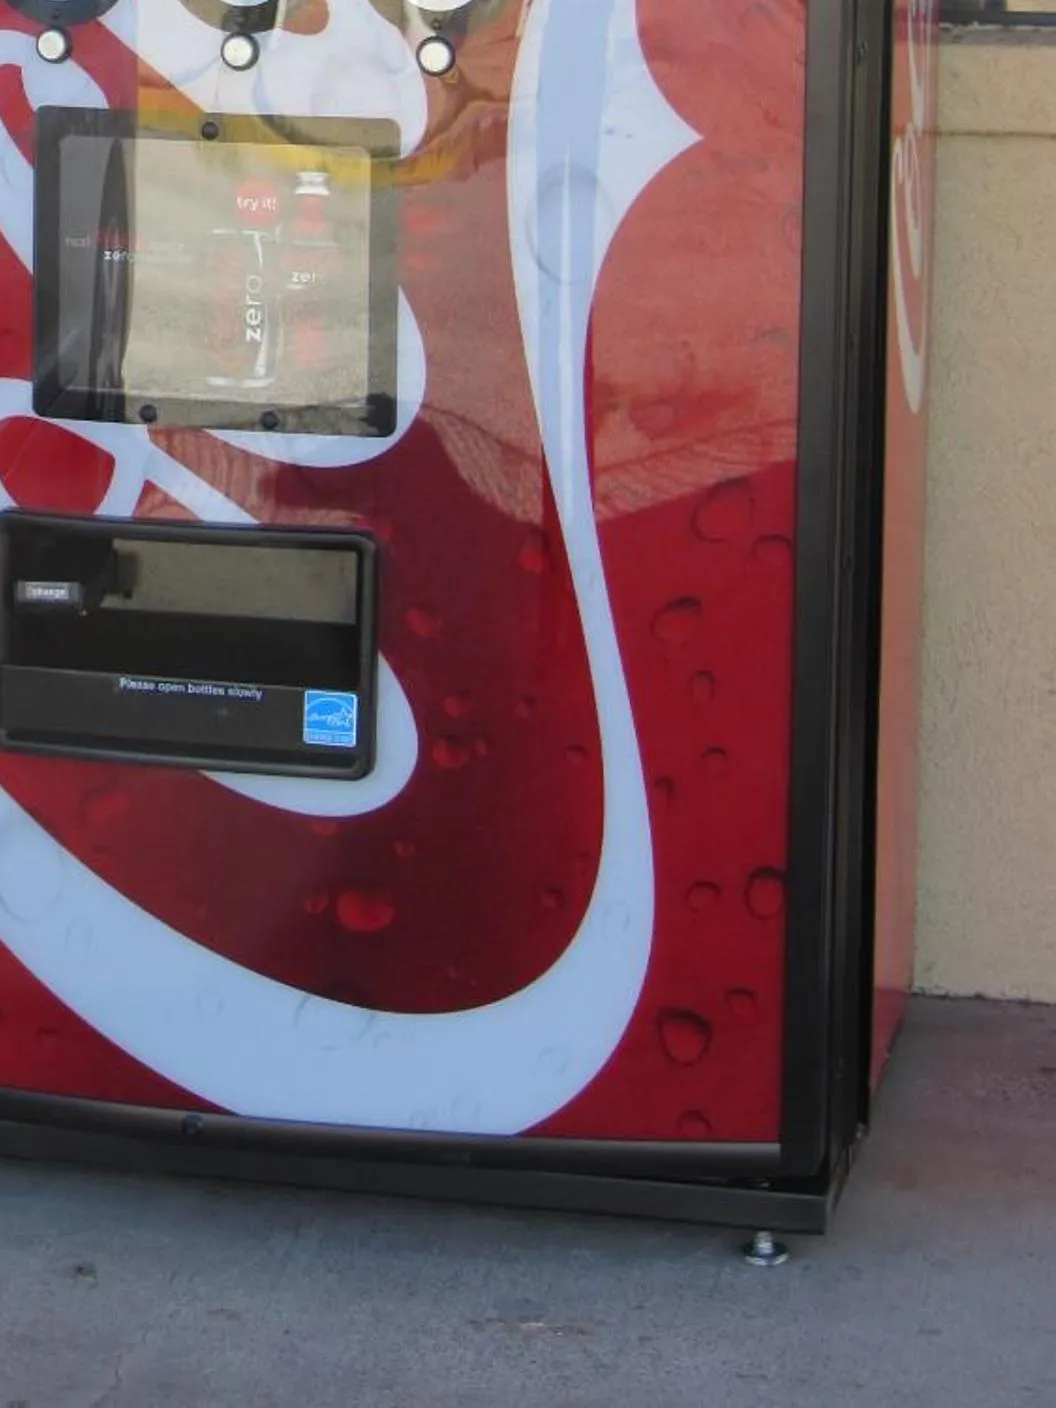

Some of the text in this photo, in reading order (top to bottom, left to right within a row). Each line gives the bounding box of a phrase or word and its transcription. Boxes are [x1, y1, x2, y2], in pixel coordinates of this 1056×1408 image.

[237, 196, 277, 211] try it!
[246, 274, 263, 342] zero
[119, 676, 264, 701] Please open bottles slowly
